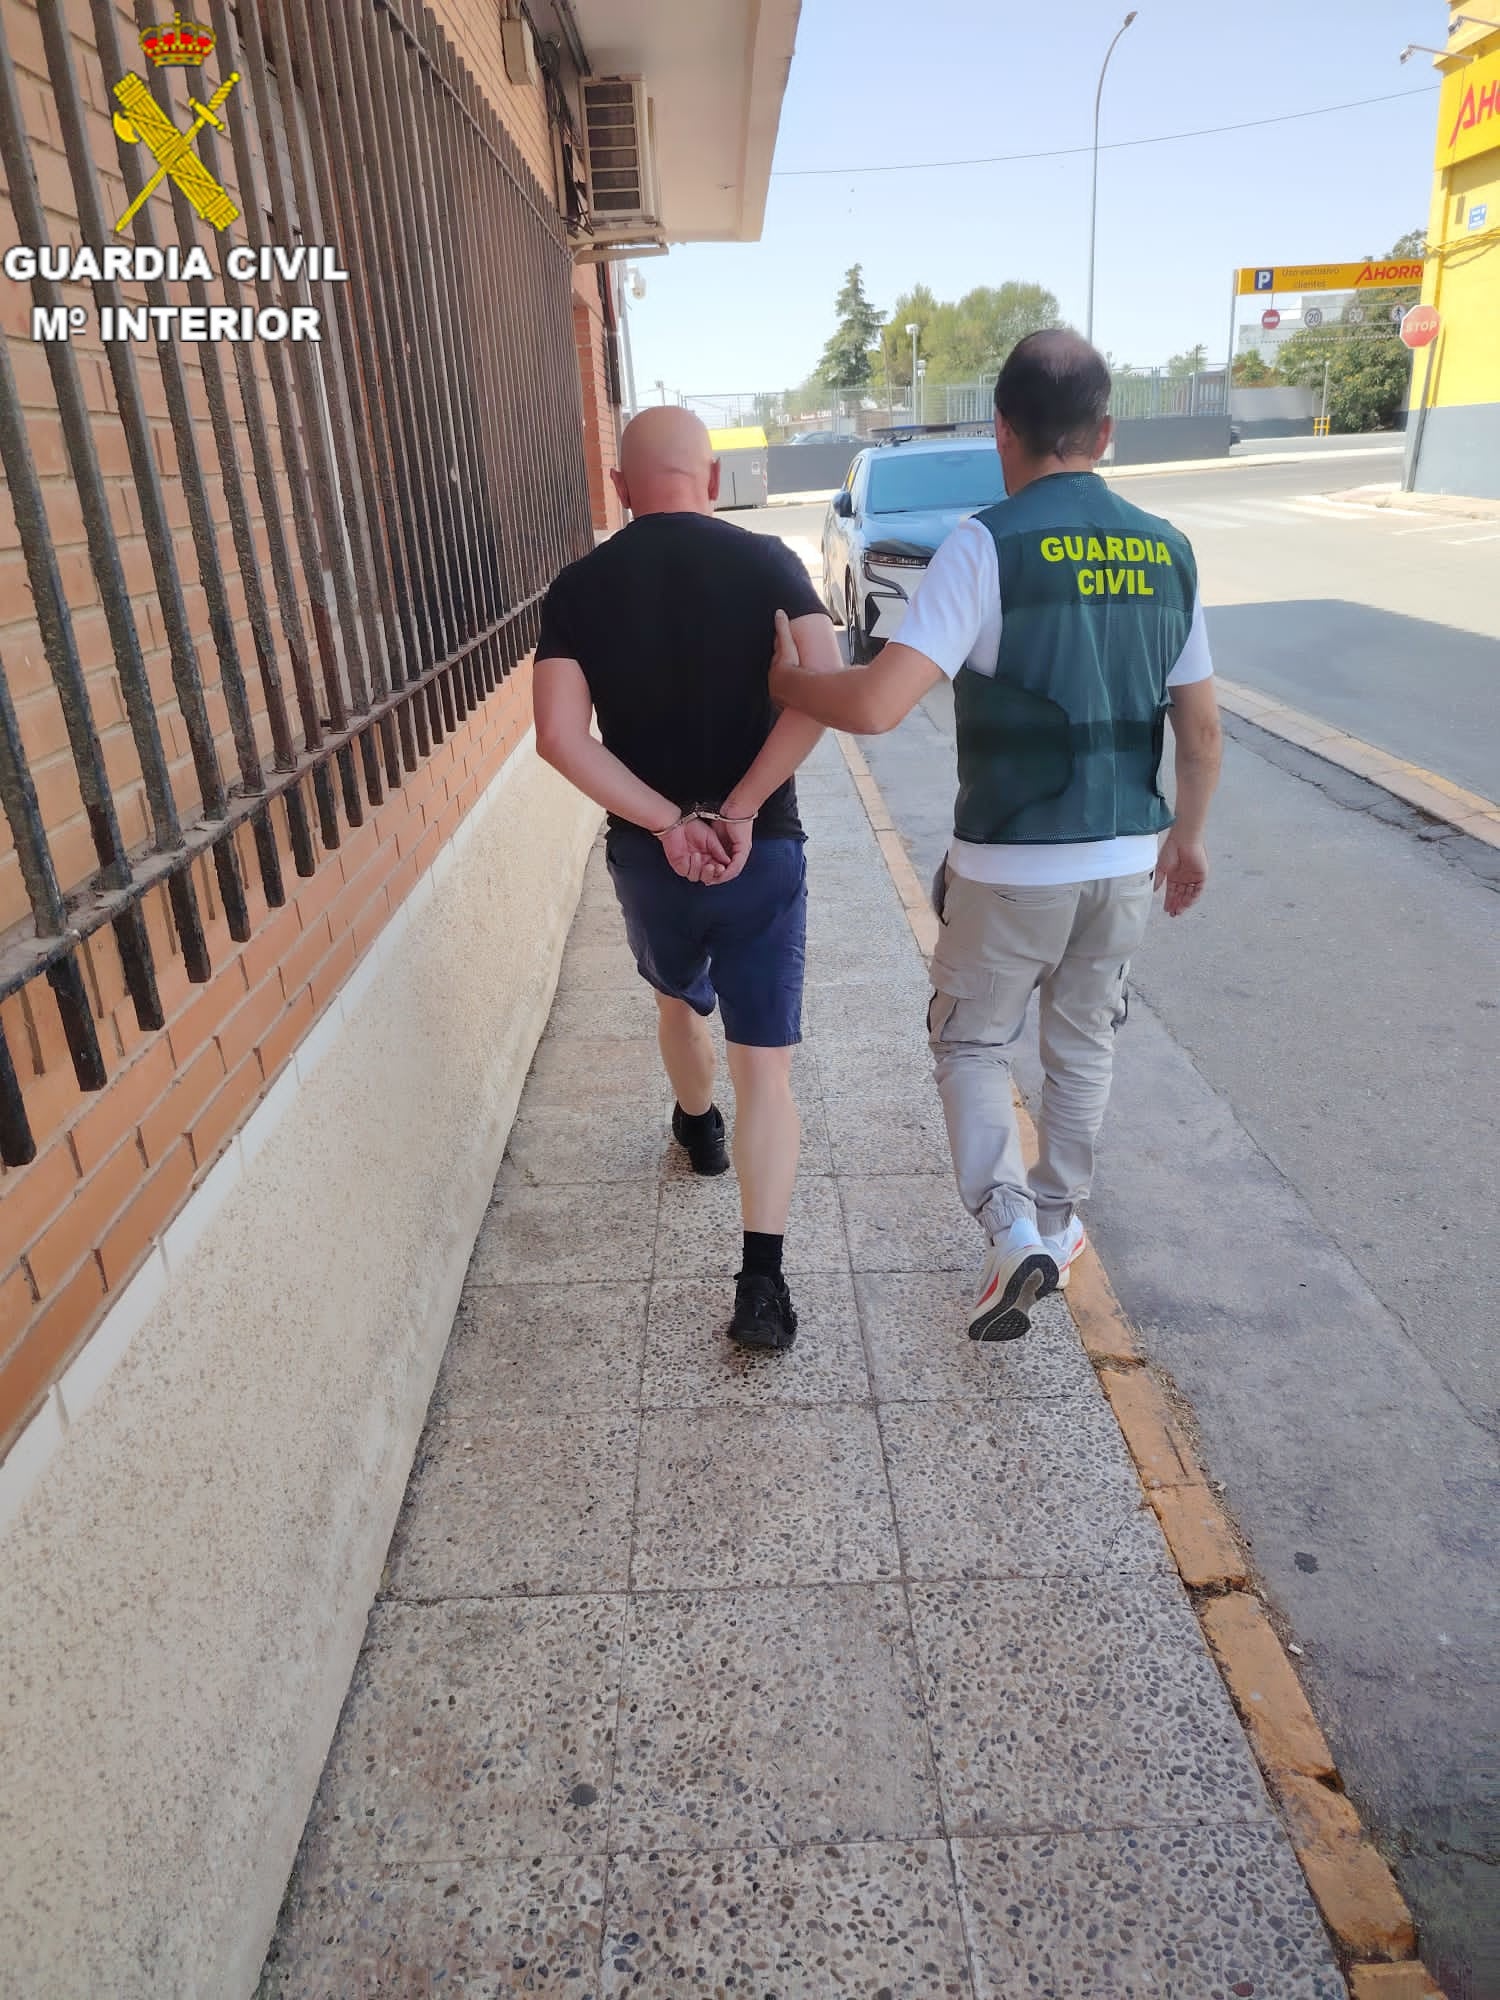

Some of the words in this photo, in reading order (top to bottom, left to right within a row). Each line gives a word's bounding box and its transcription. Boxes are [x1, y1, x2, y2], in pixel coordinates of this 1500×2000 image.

[1448, 79, 1500, 148] AH
[1257, 271, 1271, 289] P
[1354, 264, 1424, 285] AHORR
[1308, 312, 1320, 324] 20
[1406, 319, 1438, 334] STOP
[1040, 535, 1172, 566] GUARDIA
[1077, 568, 1154, 596] CIVIL
